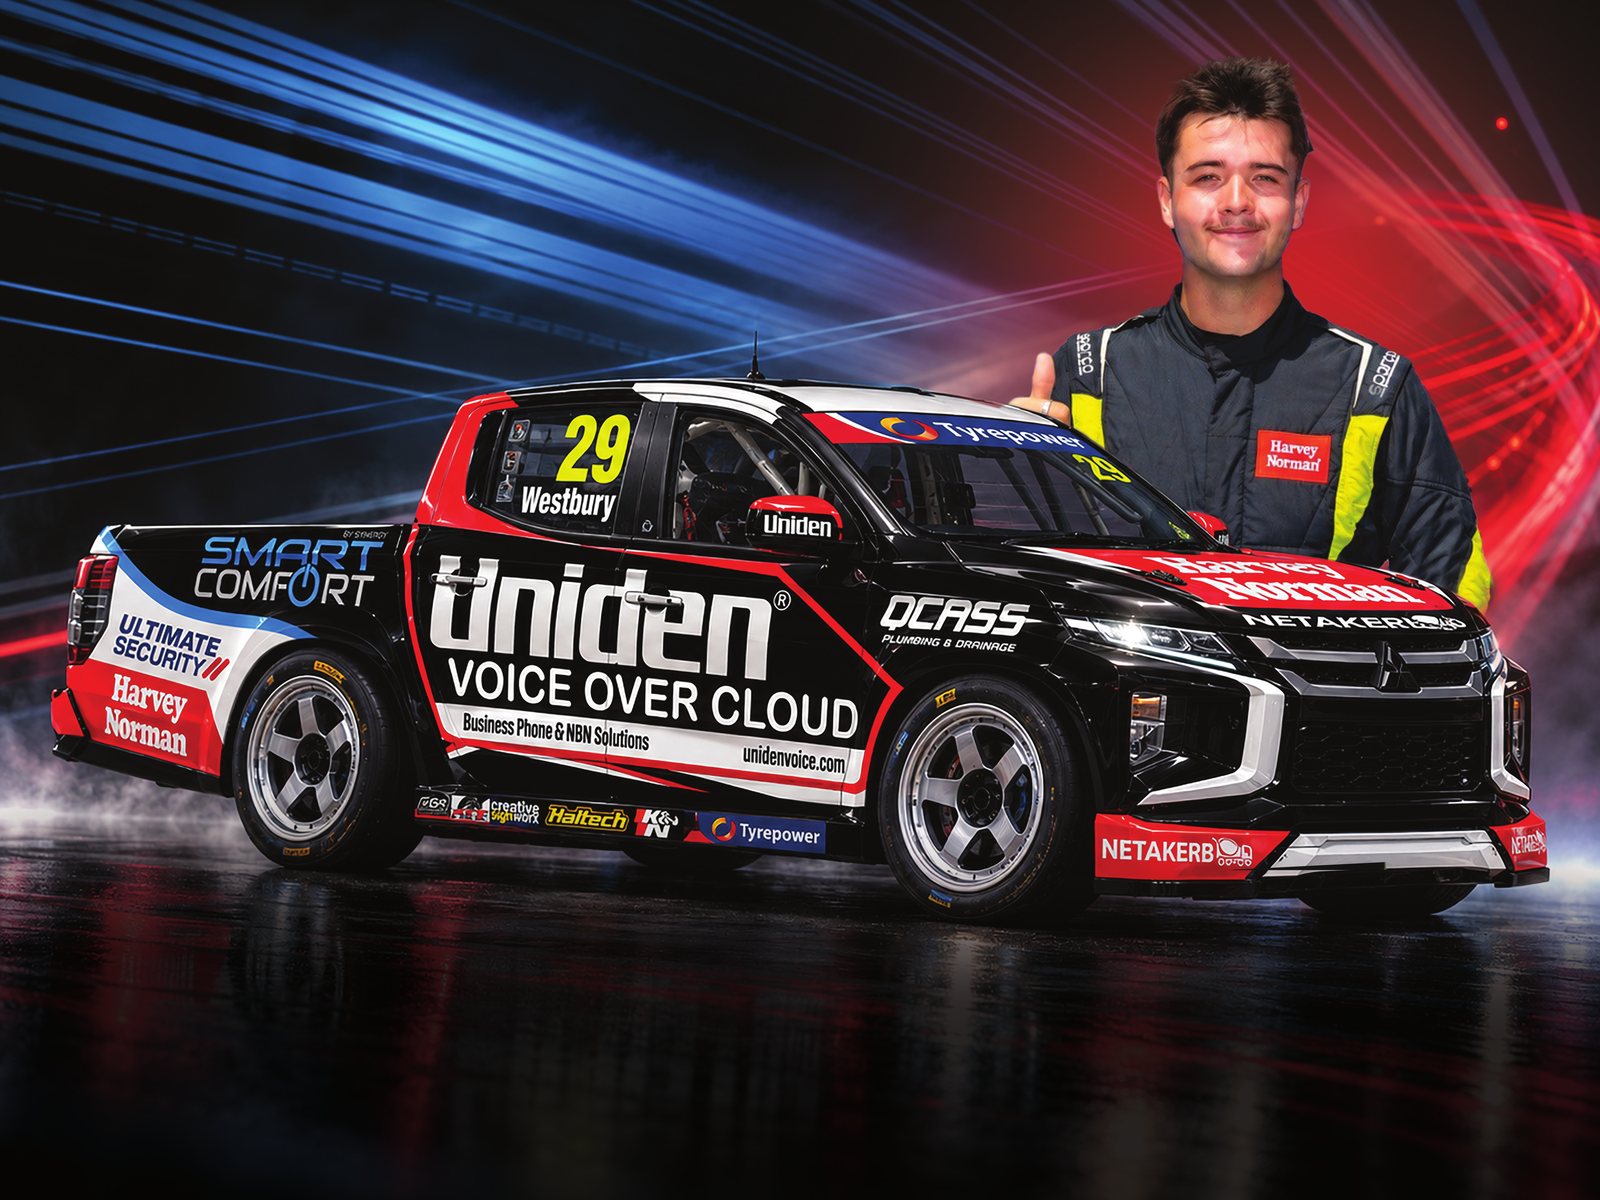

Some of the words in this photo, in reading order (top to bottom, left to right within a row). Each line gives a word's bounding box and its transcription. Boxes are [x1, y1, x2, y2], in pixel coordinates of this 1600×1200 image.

[1077, 333, 1094, 375] sparco
[555, 413, 631, 484] 29
[936, 421, 1085, 450] Tyrepower
[1270, 439, 1319, 459] Harvey
[1072, 453, 1132, 484] 29
[1266, 454, 1321, 472] Norman
[521, 485, 617, 523] Westbury
[763, 514, 832, 538] Uniden
[202, 537, 384, 570] SMART
[1143, 556, 1346, 579] Harvey
[194, 564, 375, 607] COMFORT
[1190, 577, 1426, 605] Norman
[880, 595, 1030, 636] QCASS
[119, 614, 221, 657] ULTIMATE
[882, 634, 941, 648] PLUMBING
[955, 638, 1017, 653] DRAINAGE
[113, 637, 206, 677] SECURITY
[111, 673, 187, 723] Harvey
[447, 657, 572, 707] VOICE
[584, 671, 699, 722] OVER
[711, 685, 859, 739] CLOUD
[104, 706, 187, 757] Norman
[462, 713, 515, 737] Business
[516, 718, 553, 741] Phone
[555, 724, 564, 741] &
[566, 724, 592, 744] NBN
[594, 727, 649, 751] Solutions
[742, 747, 846, 774] unidenvoice.com
[491, 801, 539, 813] creative
[491, 810, 513, 824] sign
[514, 812, 540, 824] worx
[548, 808, 627, 828] Haltech
[740, 822, 821, 845] Tyrepower
[1102, 837, 1215, 863] NETAKERB
